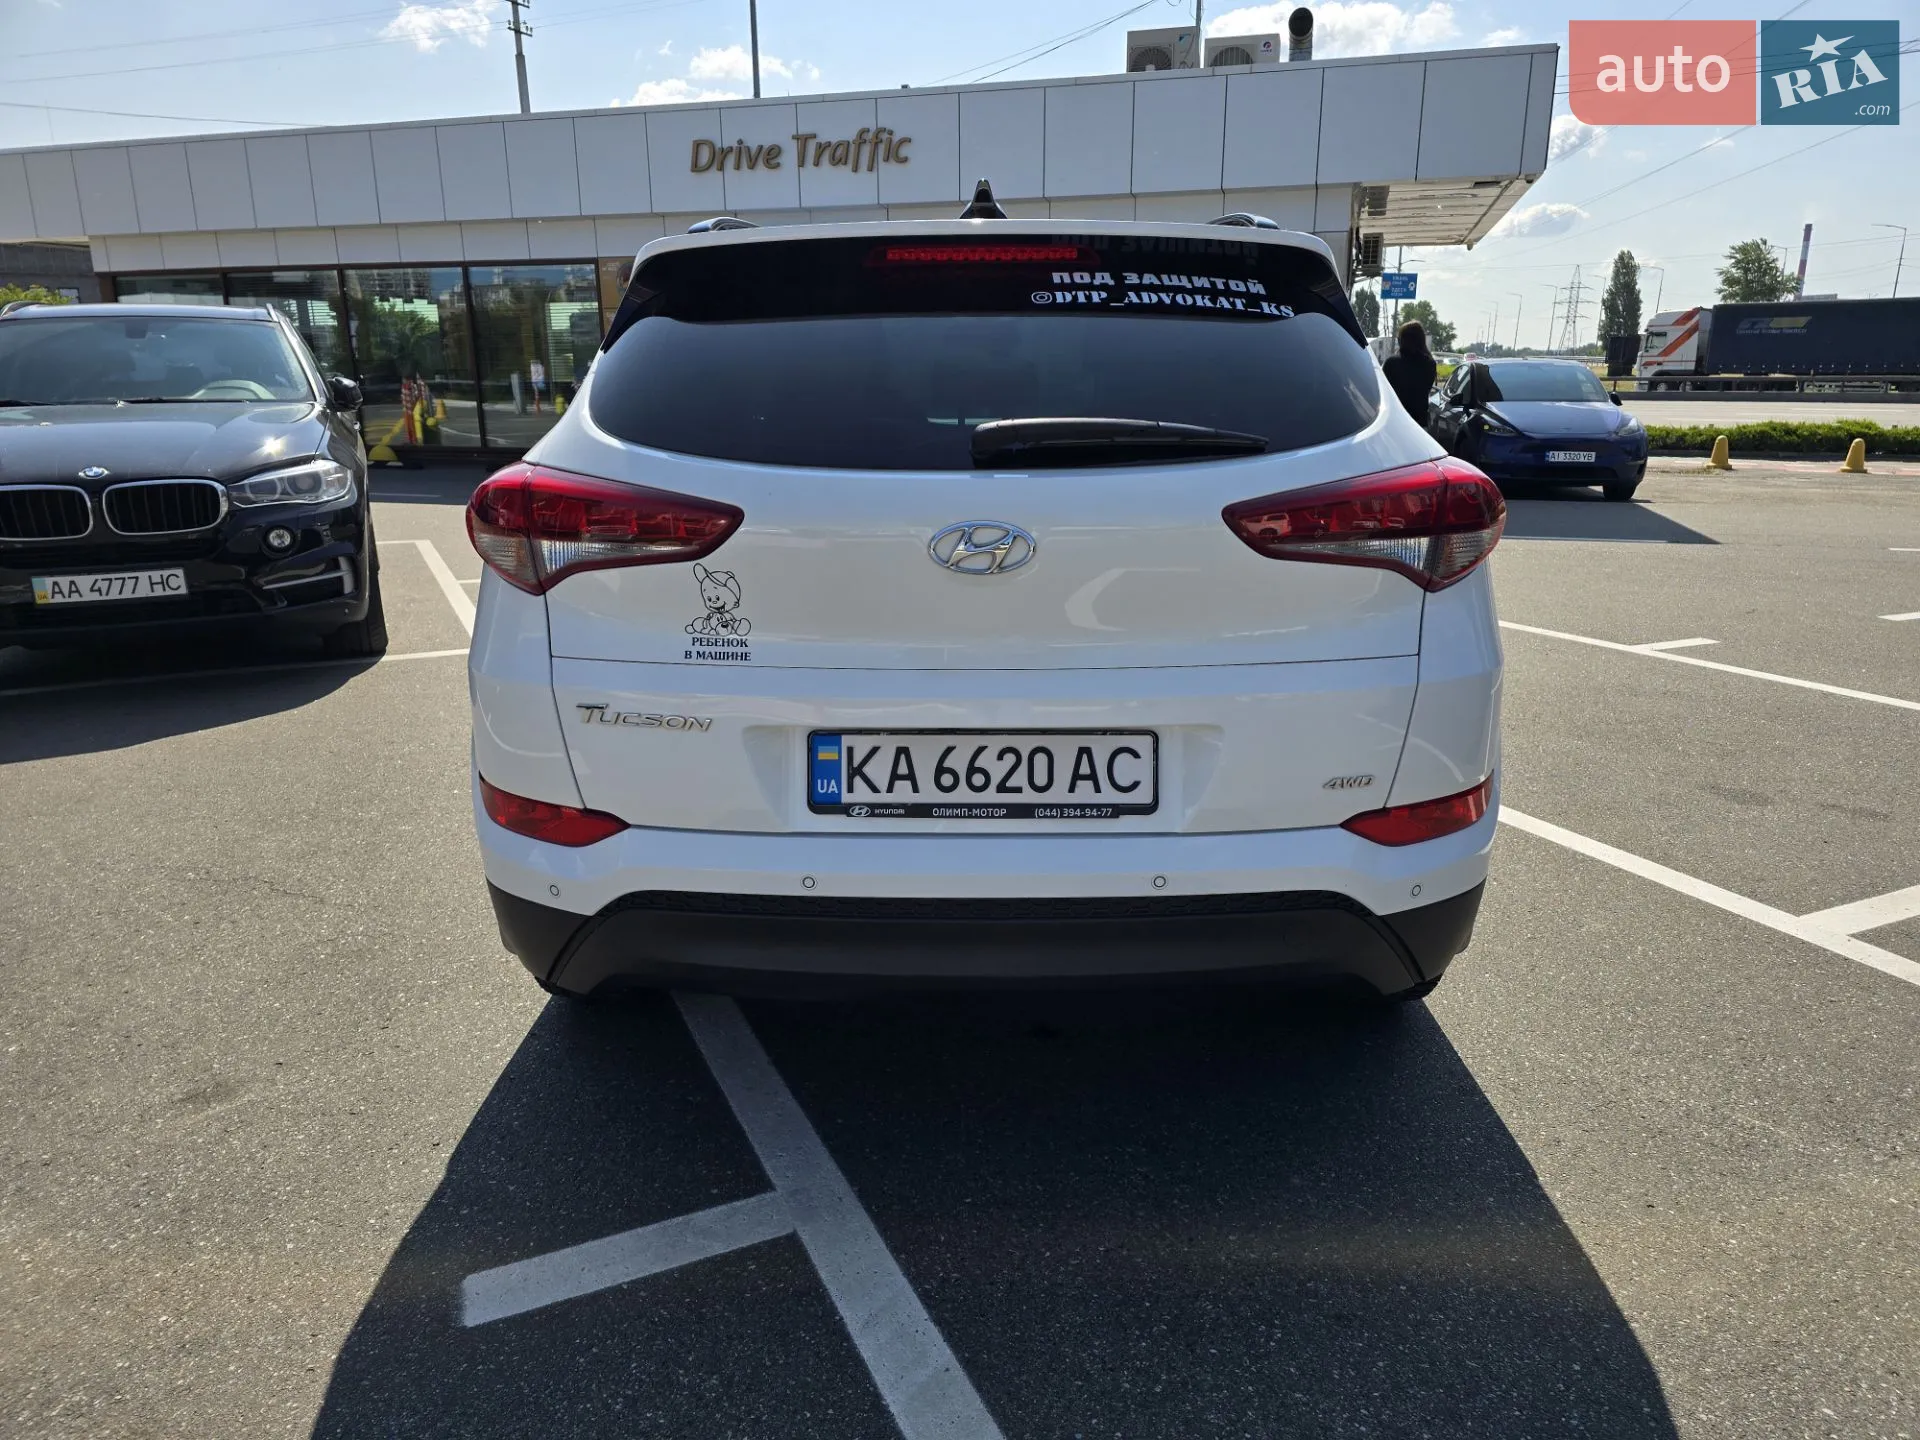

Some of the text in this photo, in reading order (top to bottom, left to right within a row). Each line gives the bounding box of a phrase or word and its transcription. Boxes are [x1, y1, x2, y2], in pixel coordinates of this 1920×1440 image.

[690, 127, 912, 173] Drive Traffic
[1052, 271, 1267, 296] ПОД ЗАЩИТОЙ
[51, 580, 83, 599] AA
[89, 576, 139, 597] 4777
[148, 573, 182, 593] HC
[691, 637, 749, 648] РЕБЕНОК
[684, 650, 752, 661] В МАШИНЕ
[817, 745, 1142, 794] UA KA 6620 AC
[1321, 774, 1375, 790] 4WD
[874, 808, 905, 816] HYUNDAI
[932, 806, 1113, 818] ОЛИМП-МОТОР (044) 394-94-77
